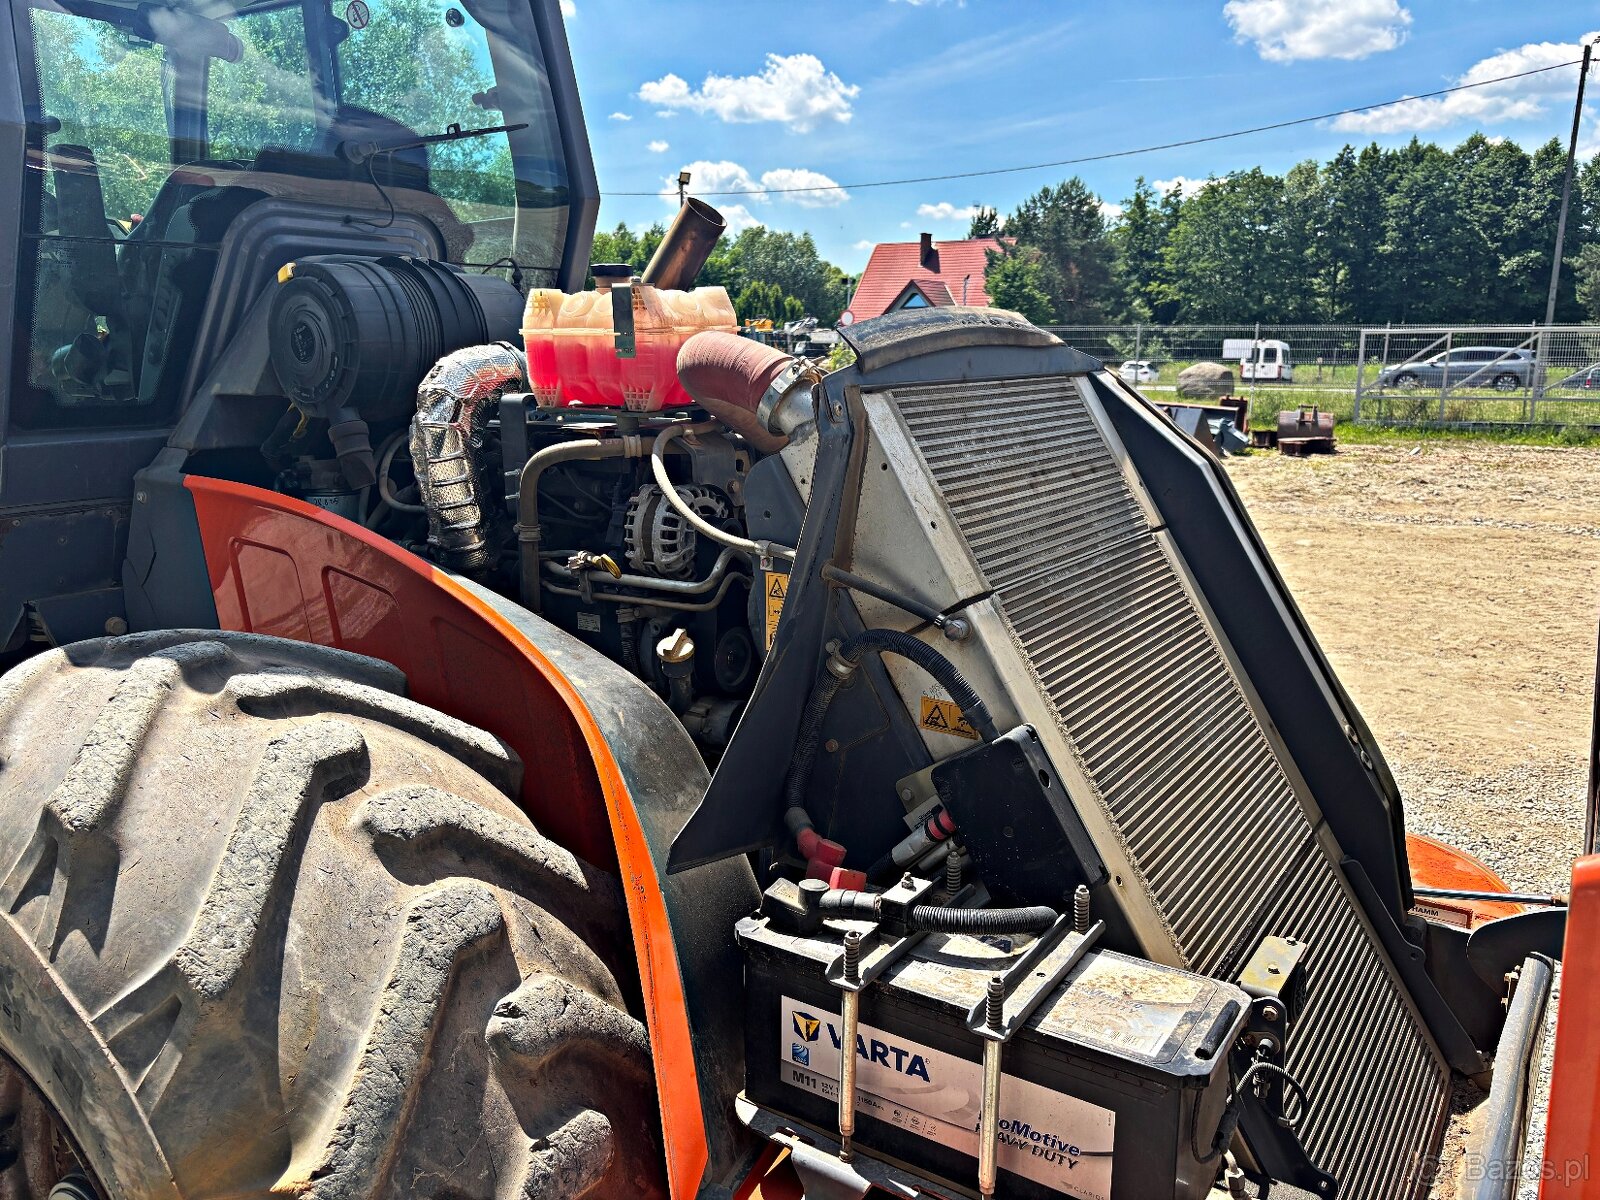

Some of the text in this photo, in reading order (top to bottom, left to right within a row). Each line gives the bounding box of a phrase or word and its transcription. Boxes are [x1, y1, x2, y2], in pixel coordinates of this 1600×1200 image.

[792, 1070, 817, 1089] M11
[979, 1110, 1081, 1157] oMotive
[1031, 1145, 1079, 1169] DUTY
